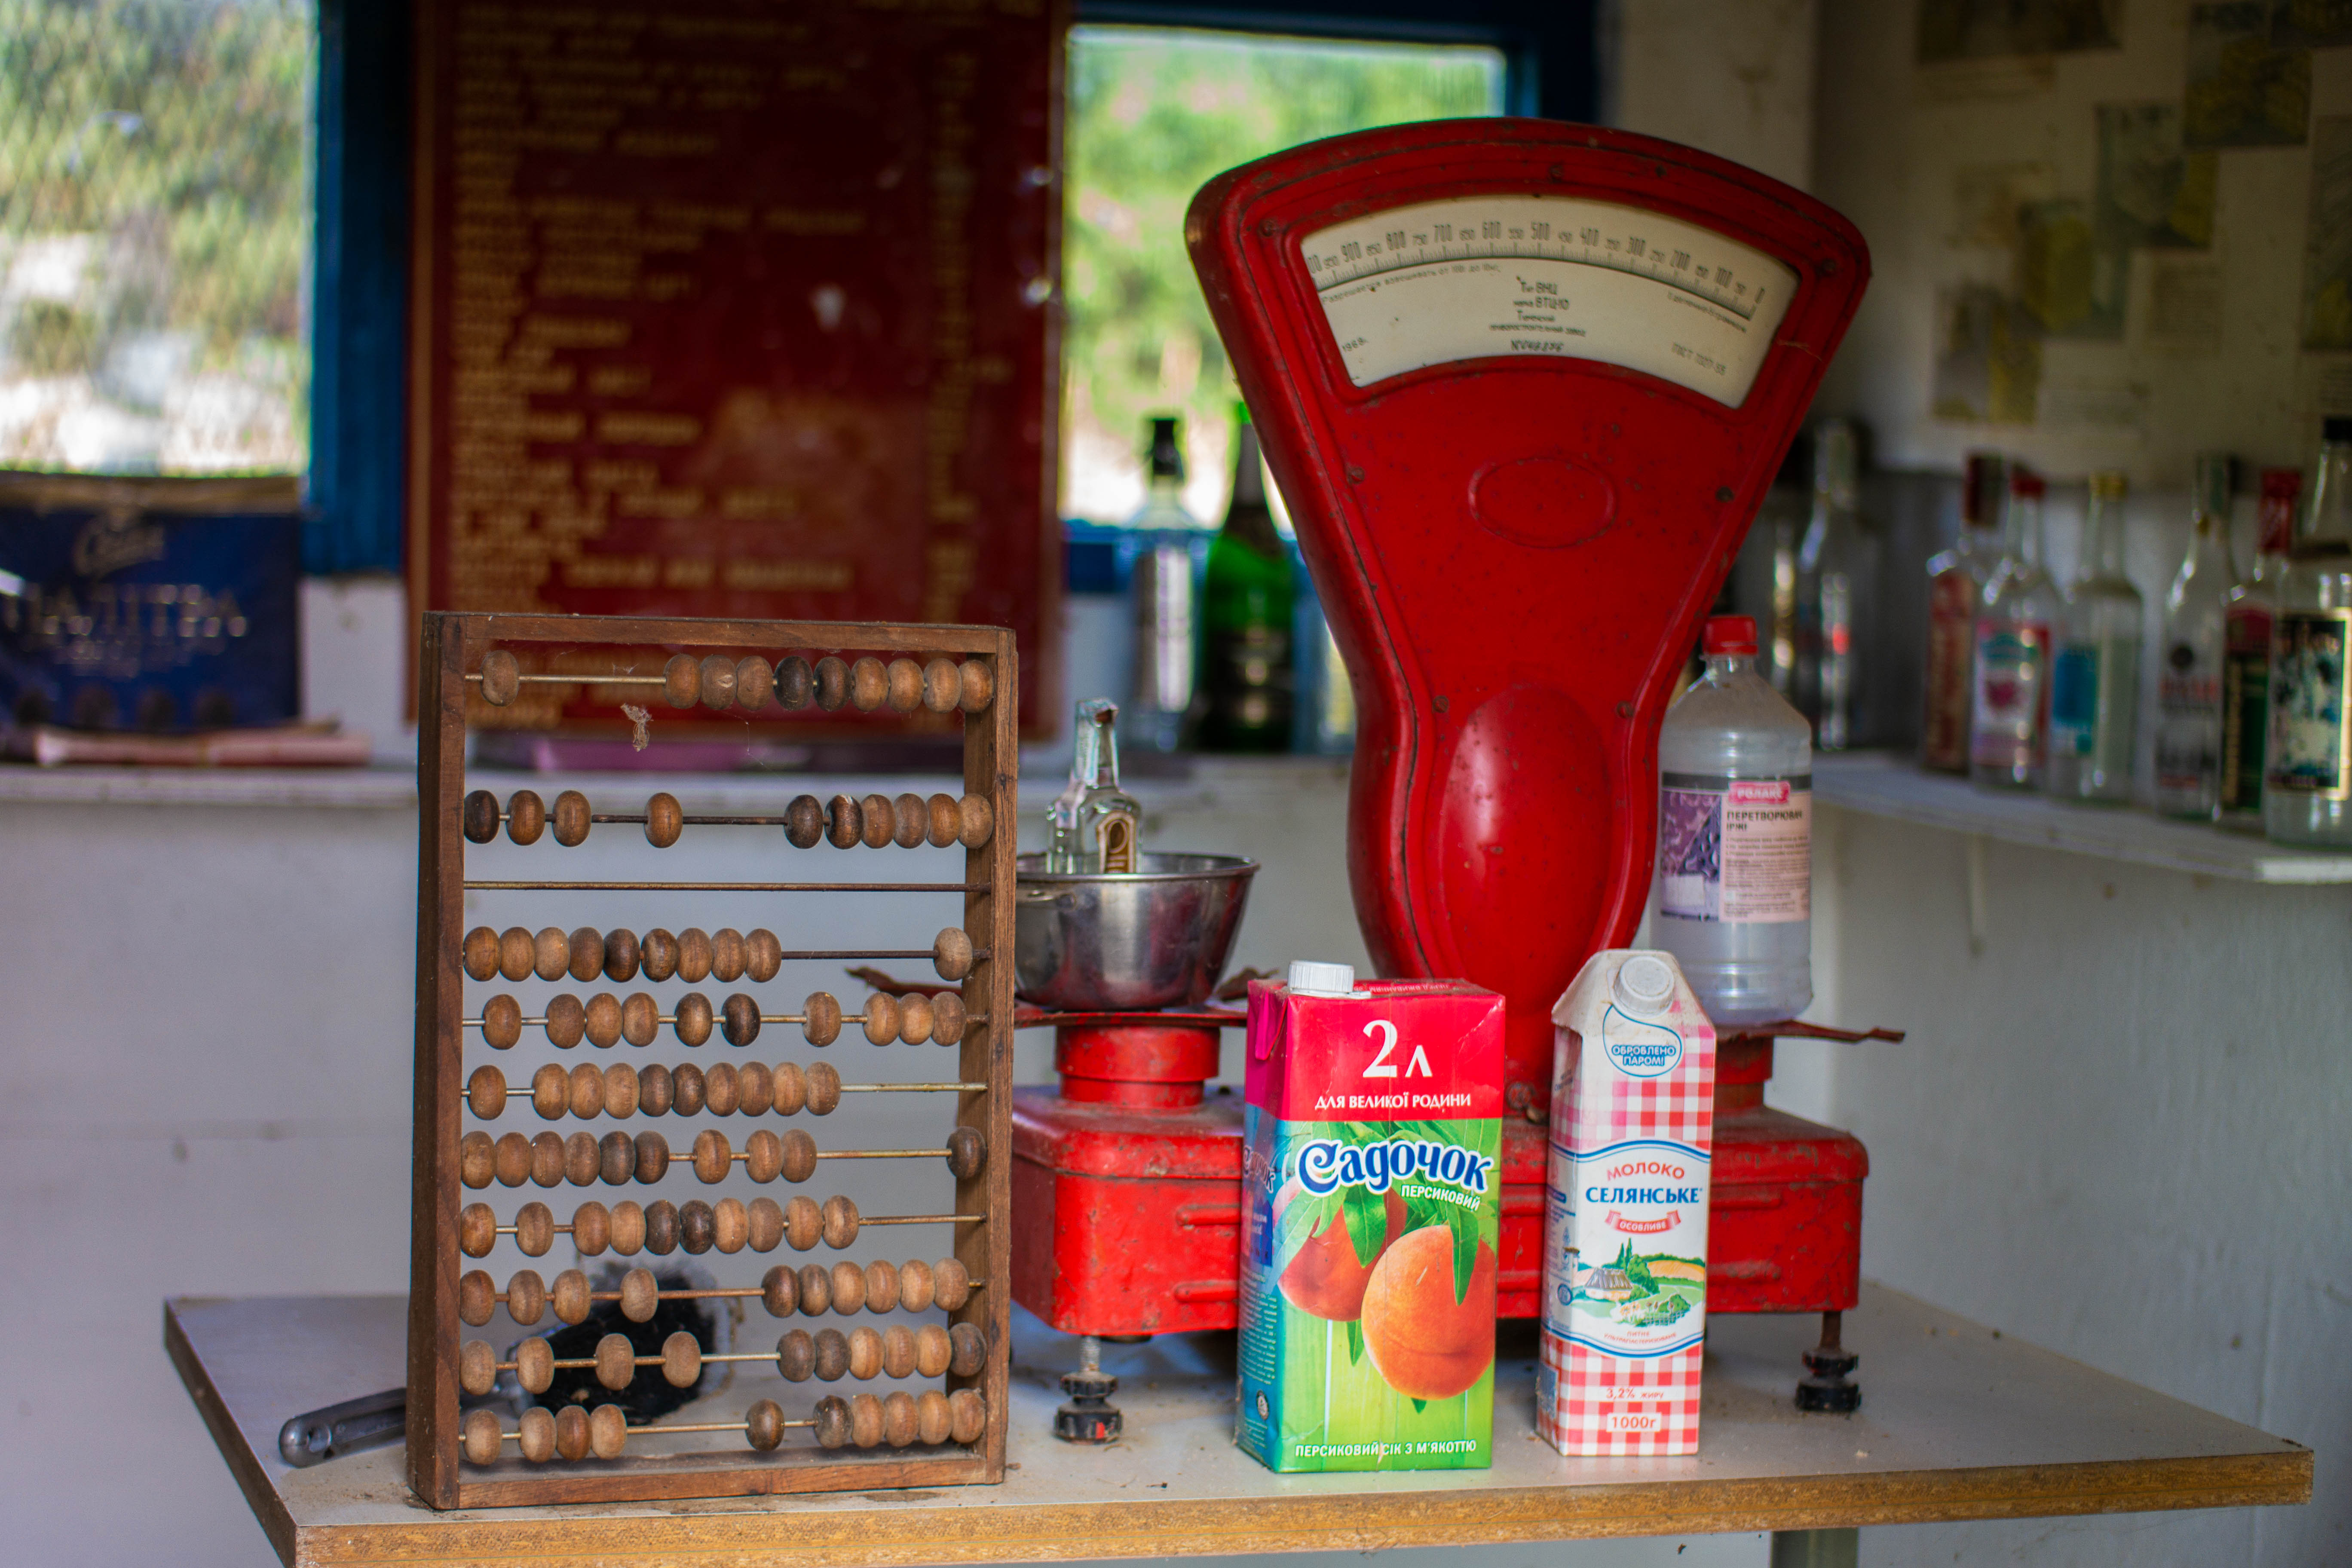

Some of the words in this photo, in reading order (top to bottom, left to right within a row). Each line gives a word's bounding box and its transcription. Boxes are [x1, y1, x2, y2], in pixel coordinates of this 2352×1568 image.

[1434, 223, 1452, 243] 700
[1482, 220, 1501, 239] 600
[1531, 221, 1550, 241] 500
[1580, 226, 1599, 247] 400
[1612, 1045, 1676, 1056] ОБРОБЛЕНО
[1315, 1095, 1344, 1110] ДЛЯ
[1349, 1092, 1409, 1108] ВЕЛИКОЇ
[1412, 1093, 1471, 1109] РОДИНИ
[1297, 1141, 1492, 1195] Садочок
[1607, 1162, 1684, 1181] МОЛОКО
[1401, 1185, 1481, 1211] ПЕРСИКОВИЙ
[1586, 1187, 1700, 1204] СЕЛЯНСЬКЕ
[1619, 1221, 1666, 1232] ОСОБЛИВЕ
[1606, 1387, 1636, 1400] 3,2%
[1640, 1391, 1665, 1400] жиру
[1612, 1416, 1656, 1429] 1000г
[1295, 1441, 1378, 1457] ПЕРСИКОВИЙ
[1381, 1442, 1402, 1455] СІК
[1415, 1439, 1477, 1455] М'ЯКОТТЮ
